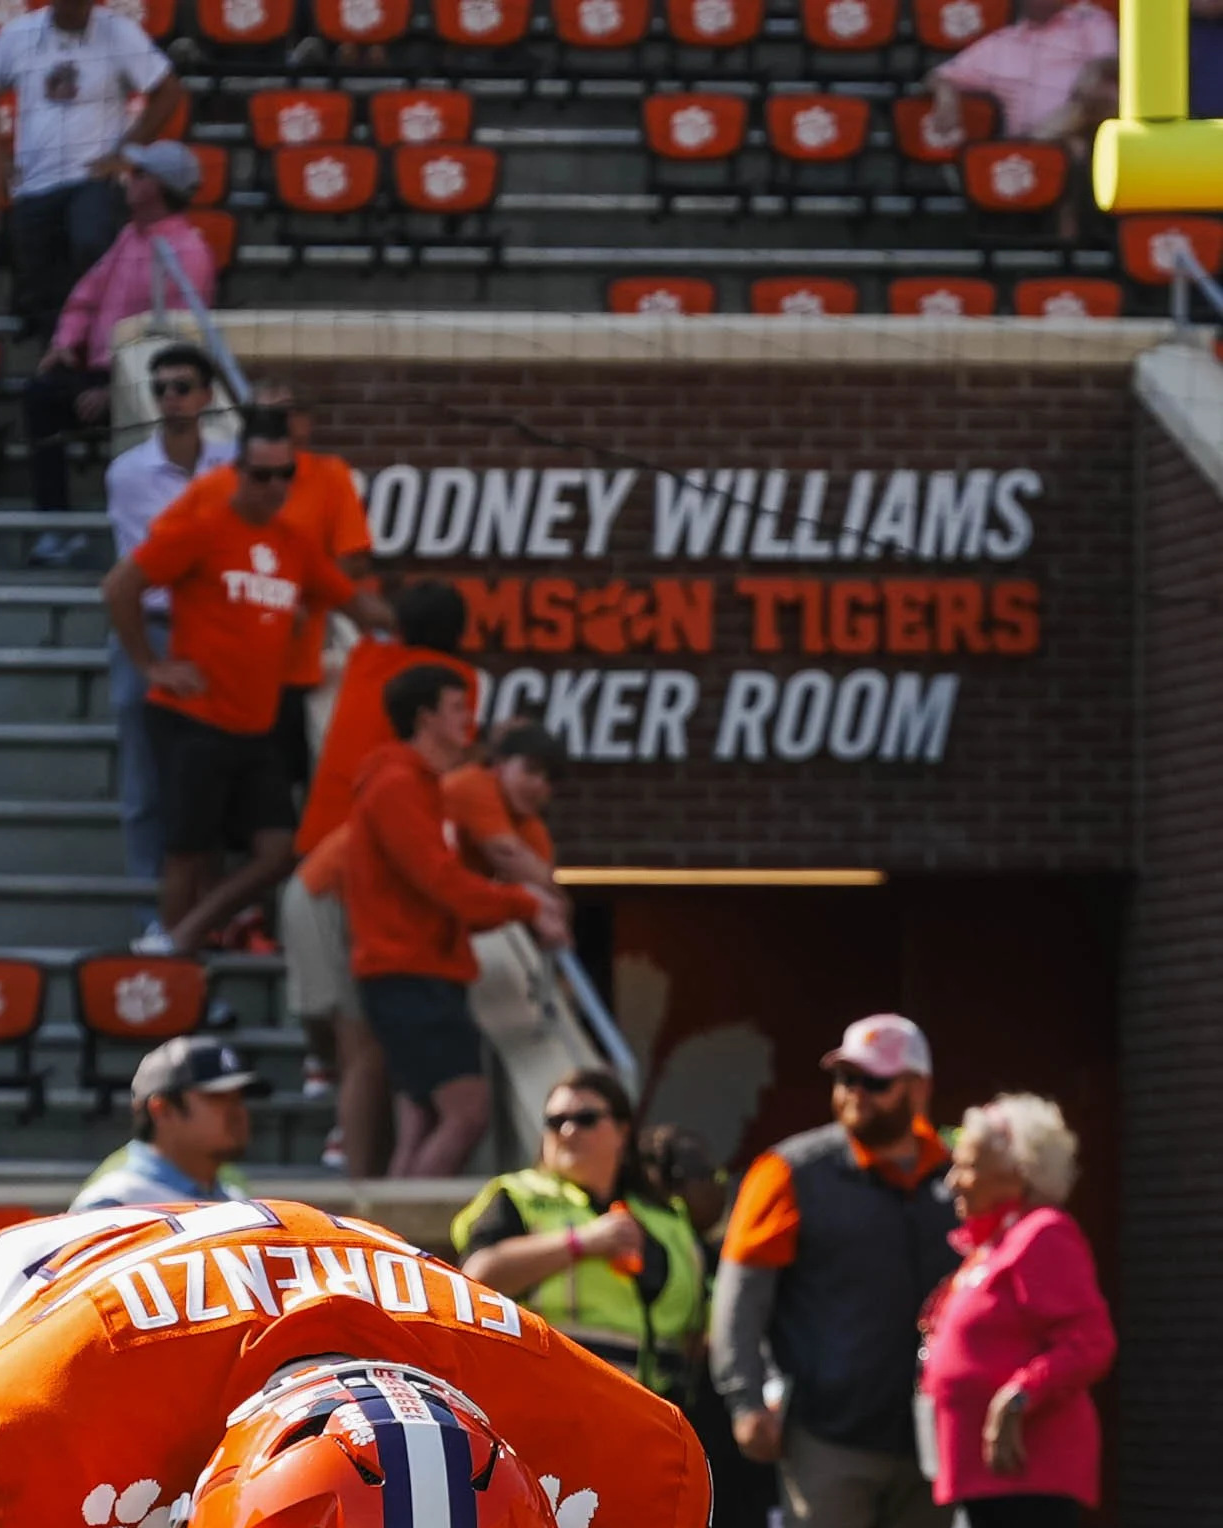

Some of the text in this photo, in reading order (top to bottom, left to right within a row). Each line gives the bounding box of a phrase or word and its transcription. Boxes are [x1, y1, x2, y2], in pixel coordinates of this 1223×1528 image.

[351, 465, 1044, 561] ODNEY WILLIAMS
[737, 578, 1041, 655] TIGERS
[475, 667, 959, 762] CKER ROOM
[110, 1244, 523, 1338] FLORENZO
